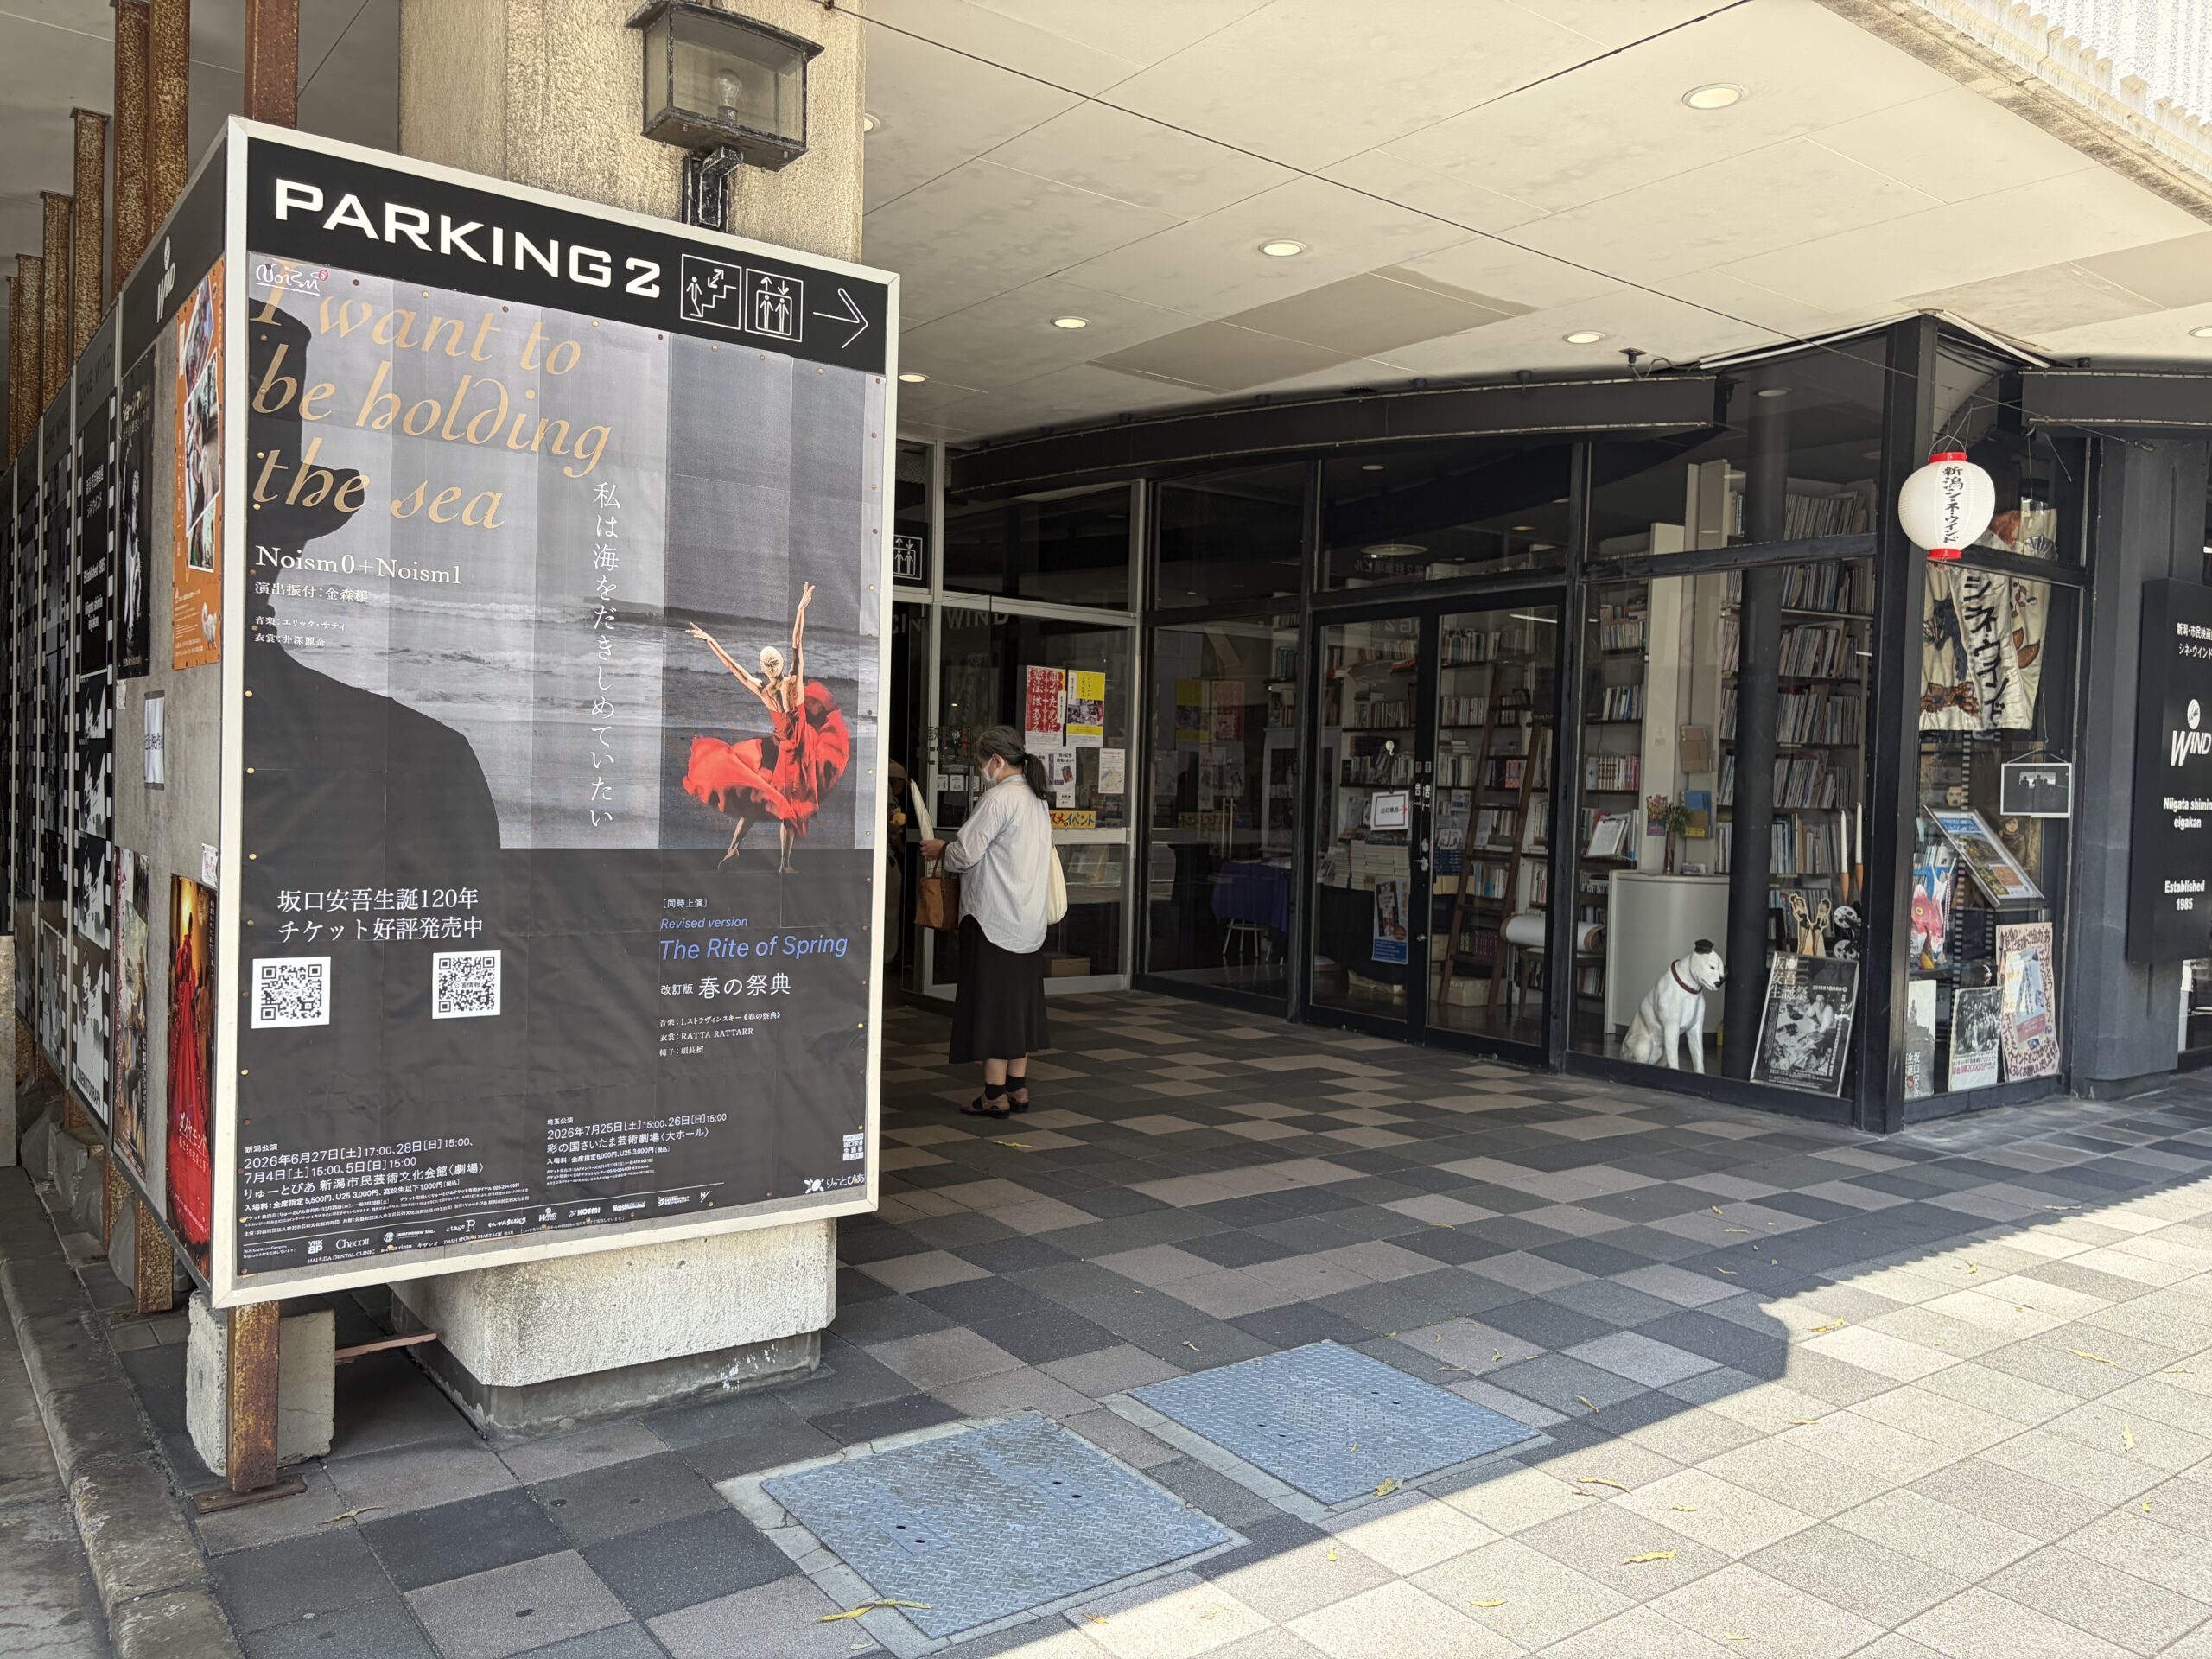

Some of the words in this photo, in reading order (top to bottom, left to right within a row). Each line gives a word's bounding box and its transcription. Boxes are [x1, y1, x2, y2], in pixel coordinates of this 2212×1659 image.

[275, 178, 612, 288] PARKING
[626, 258, 660, 297] 2
[321, 291, 502, 362] want
[521, 320, 580, 375] to
[252, 343, 336, 421] be
[355, 359, 614, 478] holding
[254, 437, 369, 513] the
[391, 480, 505, 531] sea
[2177, 622, 2212, 640] 新潟・市民映画
[590, 481, 620, 828] 私は海をだきしめていたい
[2171, 730, 2212, 766] WIND
[2164, 797, 2189, 813] Niigata
[2190, 798, 2212, 811] shimin
[2174, 816, 2202, 831] eigakan
[2164, 880, 2205, 893] Established
[277, 887, 479, 912] 坂口安吾生誕120年
[2176, 897, 2194, 911] 1985
[278, 916, 482, 943] チケット好評発売中
[660, 918, 705, 929] Revised
[709, 918, 747, 927] version
[660, 939, 700, 960] The
[707, 938, 749, 957] Rite
[755, 935, 779, 956] of
[782, 935, 848, 959] Spring
[660, 983, 694, 995] 改訂版
[698, 973, 791, 999] 春の祭典
[714, 1028, 753, 1039] RATTARR
[244, 1181, 315, 1200] りゅーとぴあ
[577, 1207, 601, 1216] KOSMI
[308, 1245, 323, 1255] ap
